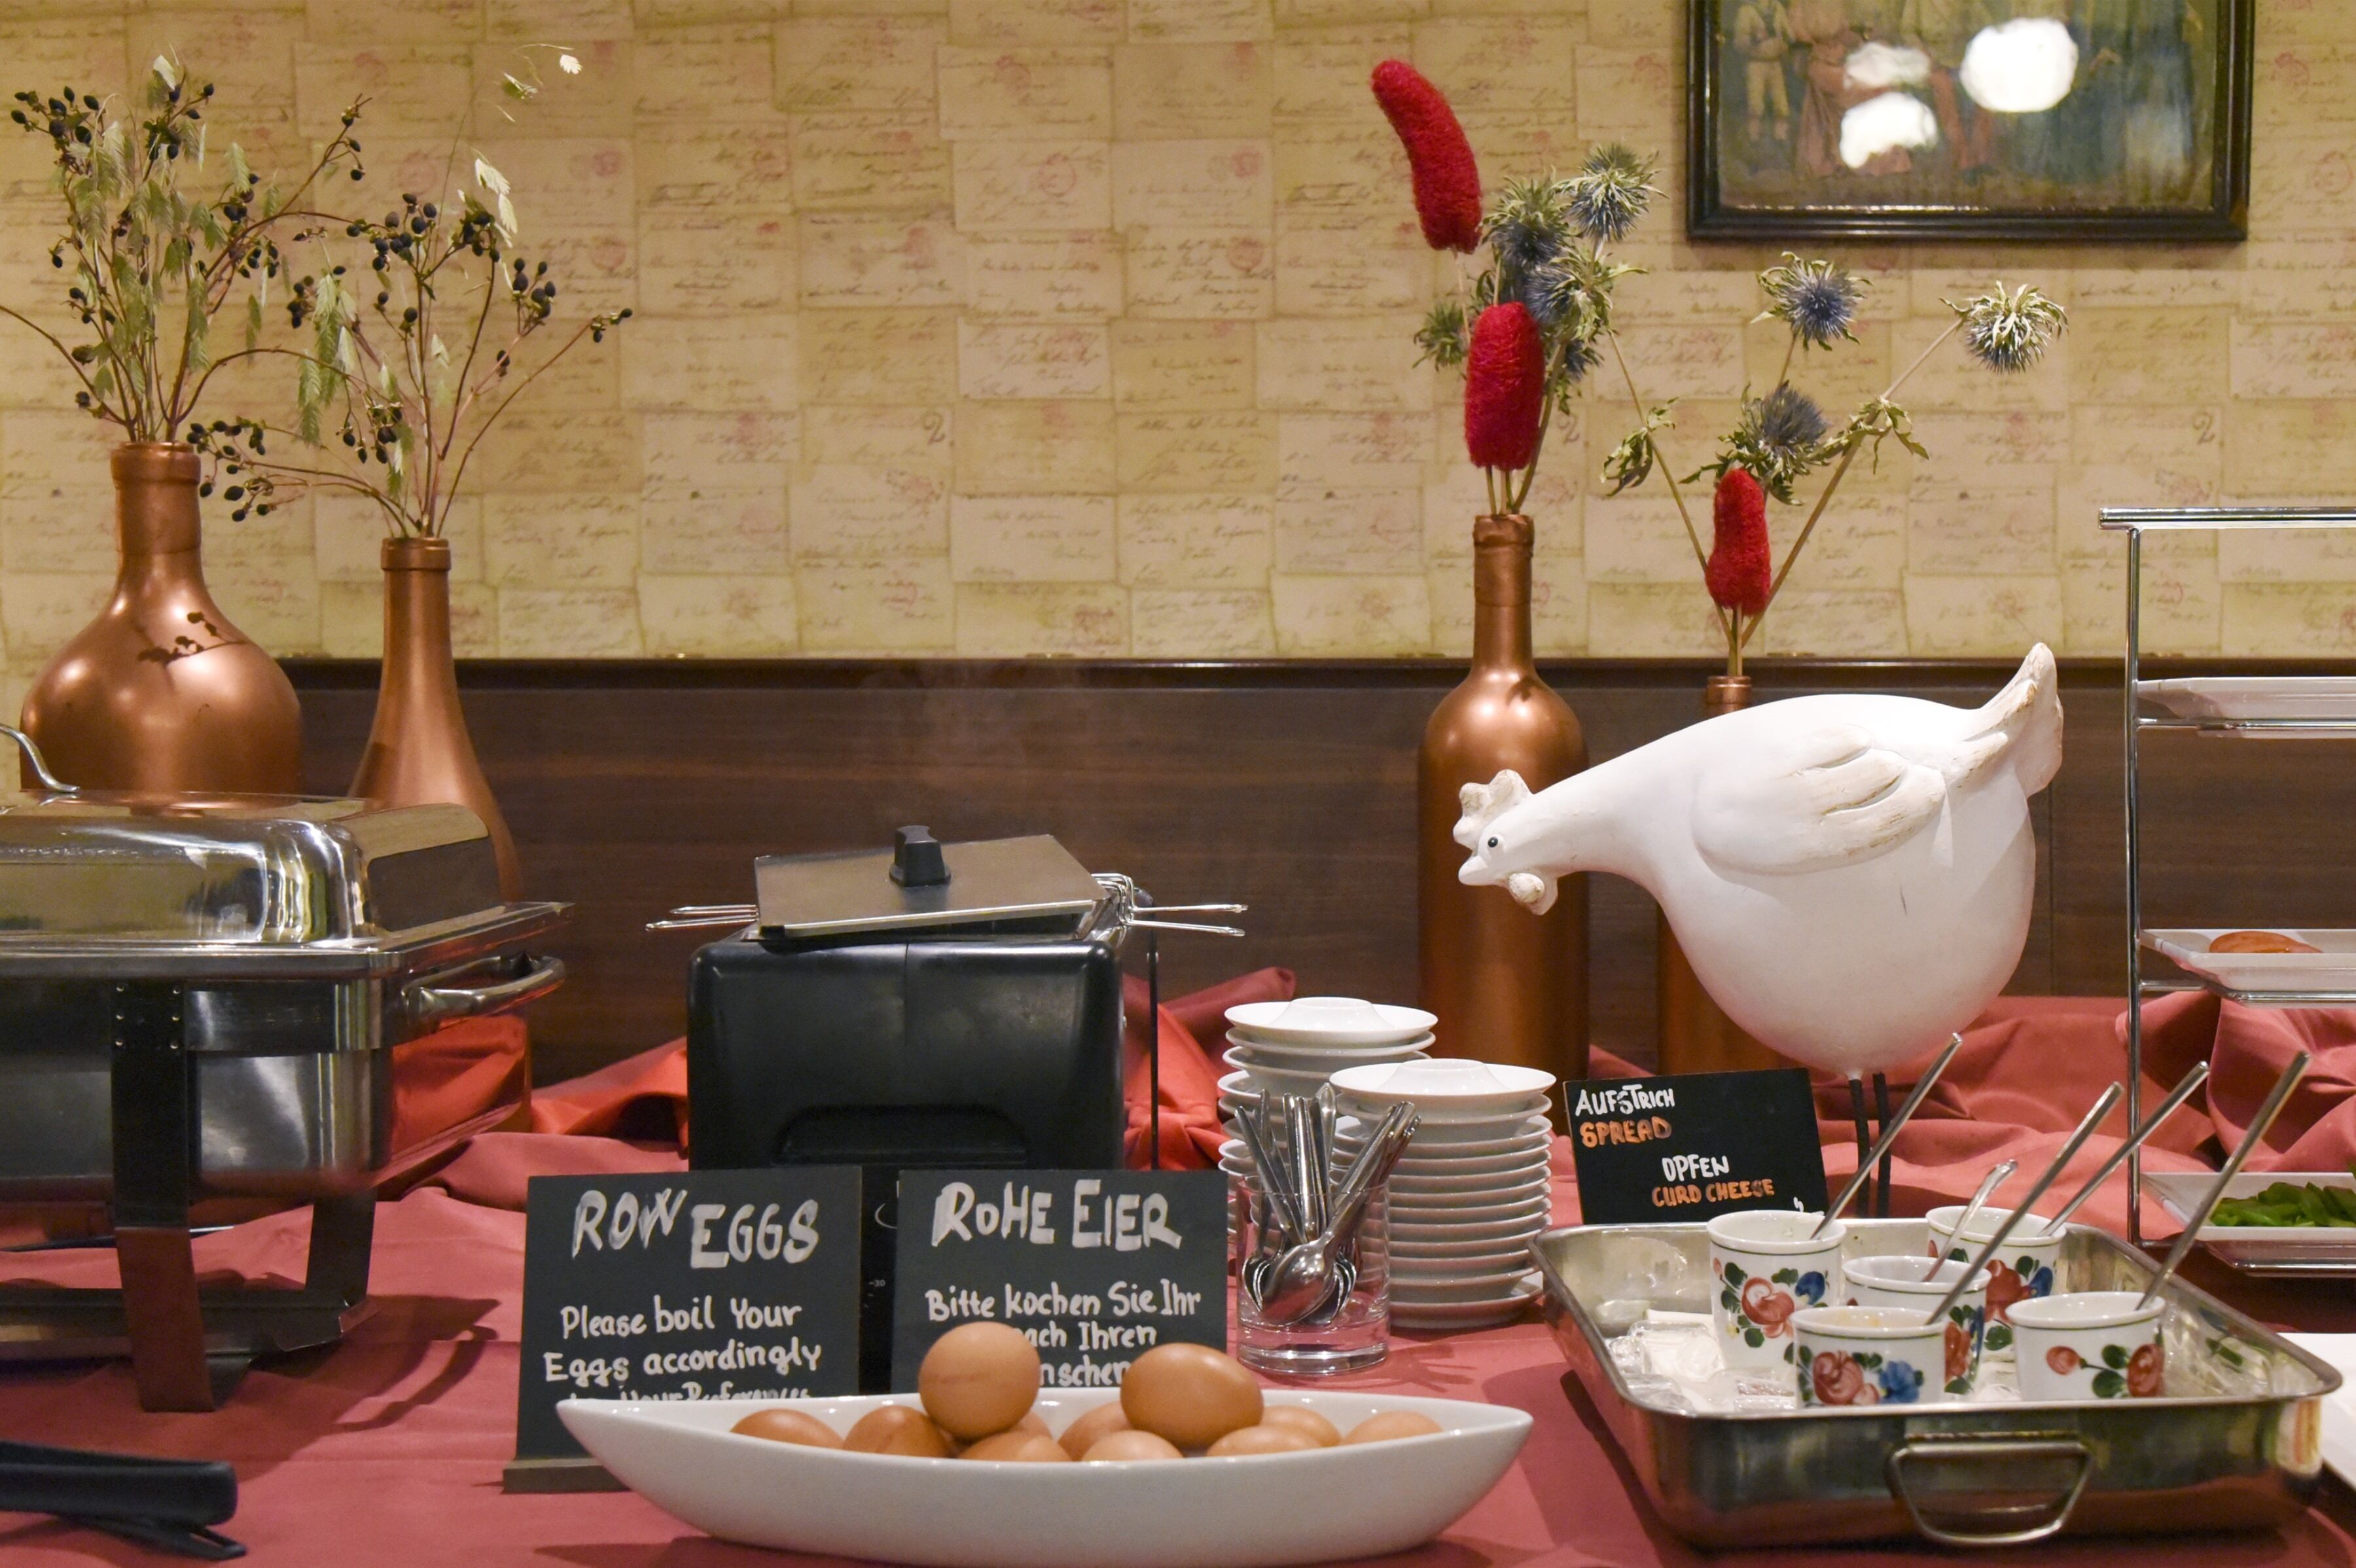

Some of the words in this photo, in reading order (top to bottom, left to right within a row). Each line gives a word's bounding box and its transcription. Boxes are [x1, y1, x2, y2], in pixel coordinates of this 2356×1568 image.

[1575, 1084, 1675, 1116] AUFSTRICH
[1579, 1116, 1672, 1149] SPREAD
[1651, 1184, 1702, 1207] CURD
[1705, 1178, 1775, 1202] CHEESE
[571, 1187, 687, 1258] ROW
[690, 1199, 819, 1269] EGGS
[1072, 1179, 1183, 1251] EIER
[560, 1304, 647, 1339] Please
[654, 1294, 715, 1333] boil
[730, 1298, 802, 1330] Your
[925, 1285, 995, 1321] Bitte
[1108, 1281, 1156, 1316] Sie
[1160, 1278, 1202, 1315] Ihr
[1014, 1320, 1067, 1347] ach
[1078, 1320, 1157, 1351] Ihren
[543, 1351, 630, 1388] Eggs
[643, 1336, 821, 1376] accordingly
